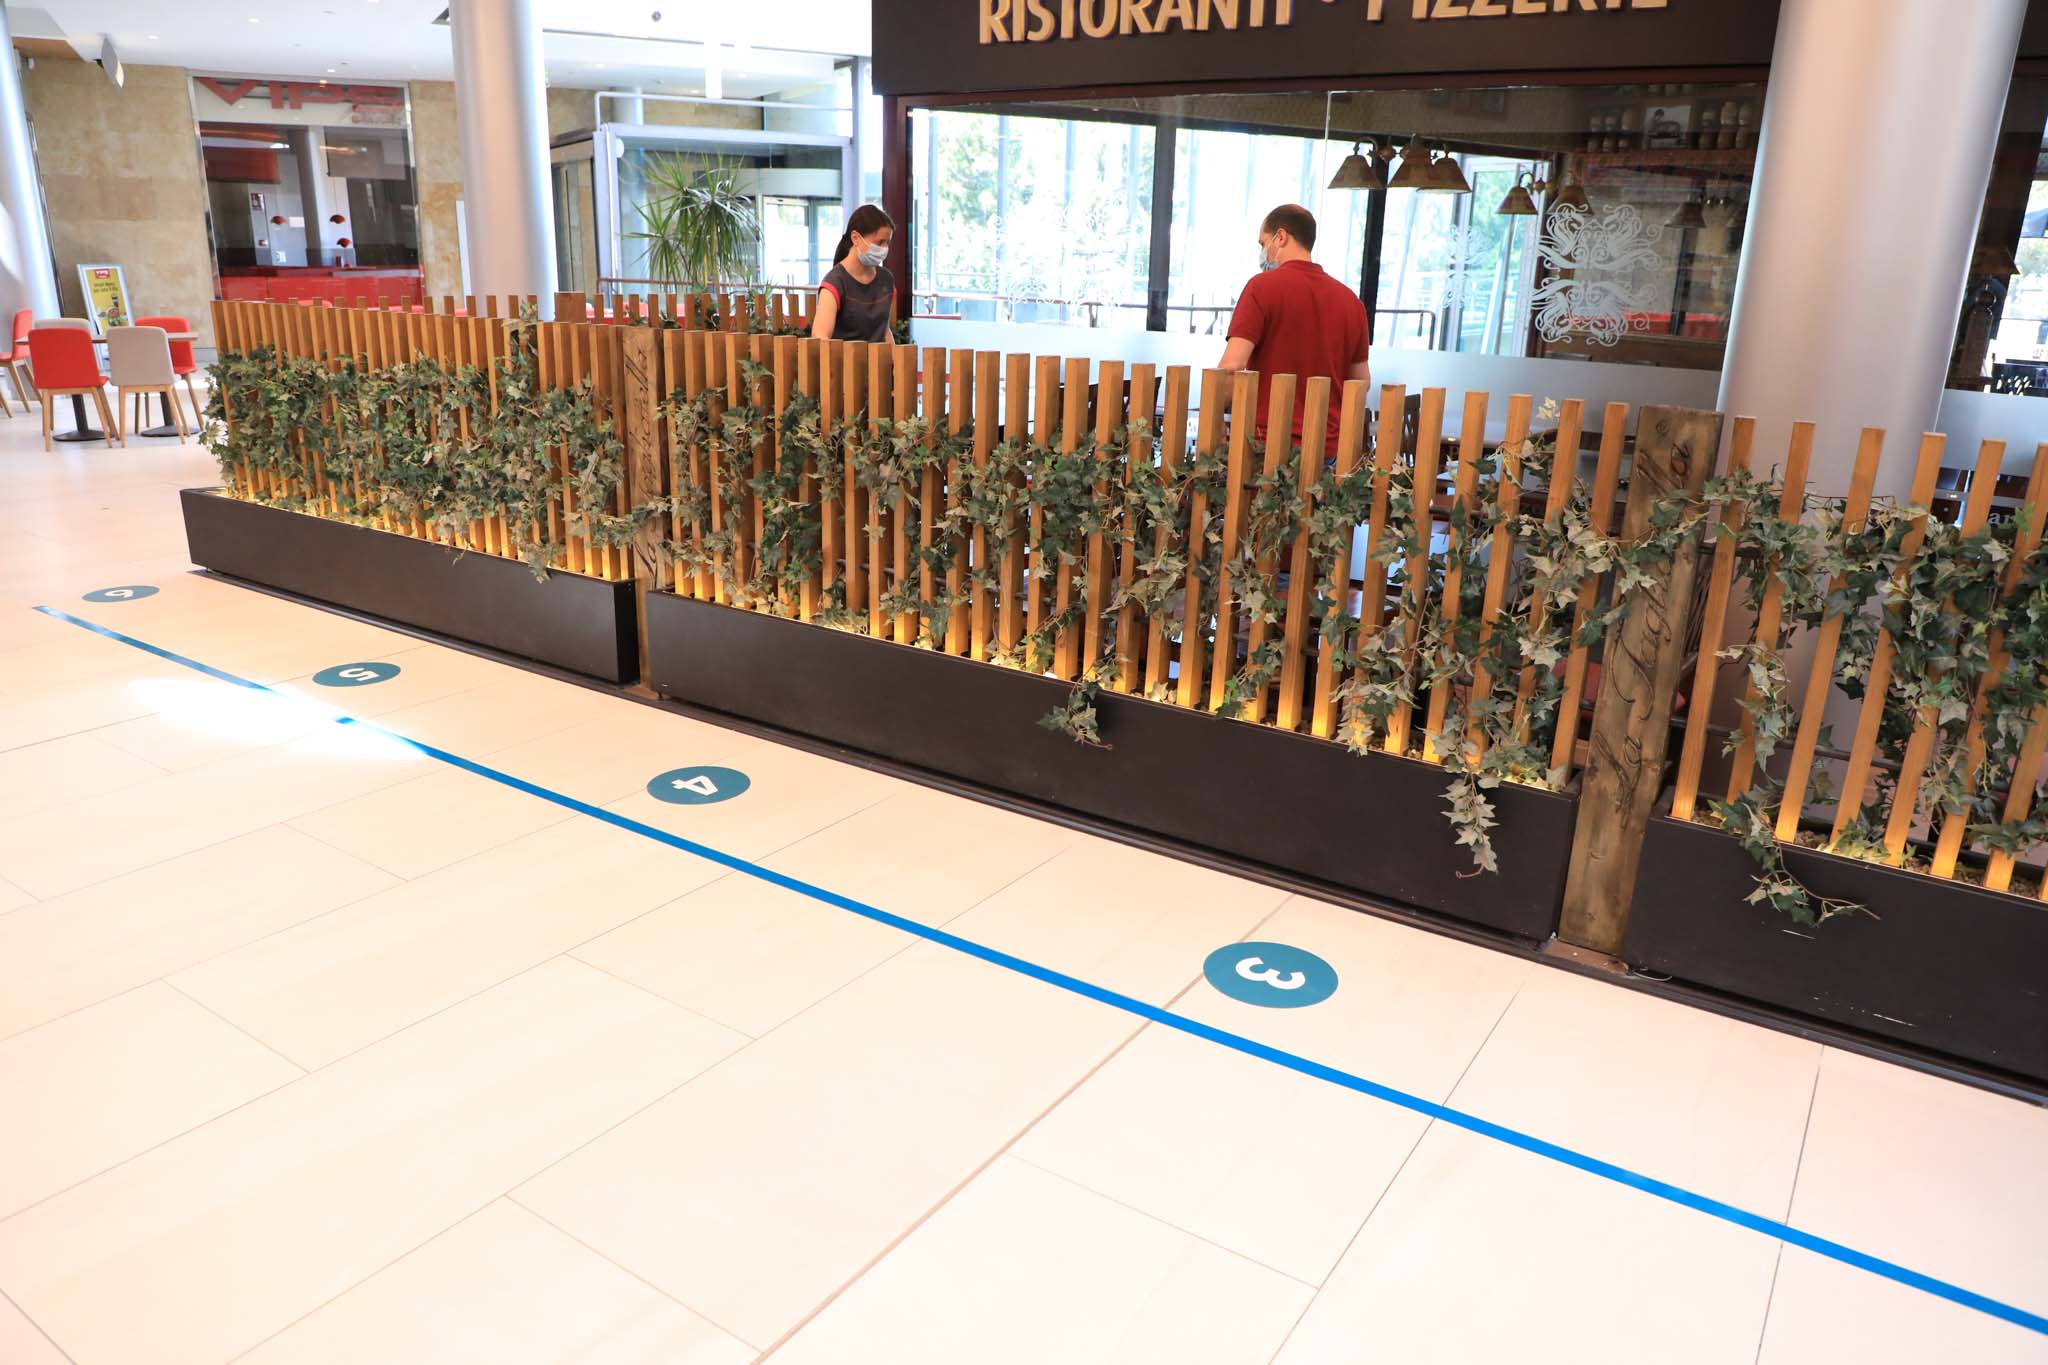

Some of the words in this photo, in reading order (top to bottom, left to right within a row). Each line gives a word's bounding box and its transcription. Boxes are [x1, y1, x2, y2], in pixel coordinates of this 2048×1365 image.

[104, 589, 133, 598] 6
[338, 668, 379, 681] 5
[671, 775, 718, 796] 4
[1595, 731, 1642, 831] La
[1235, 957, 1306, 990] 3
